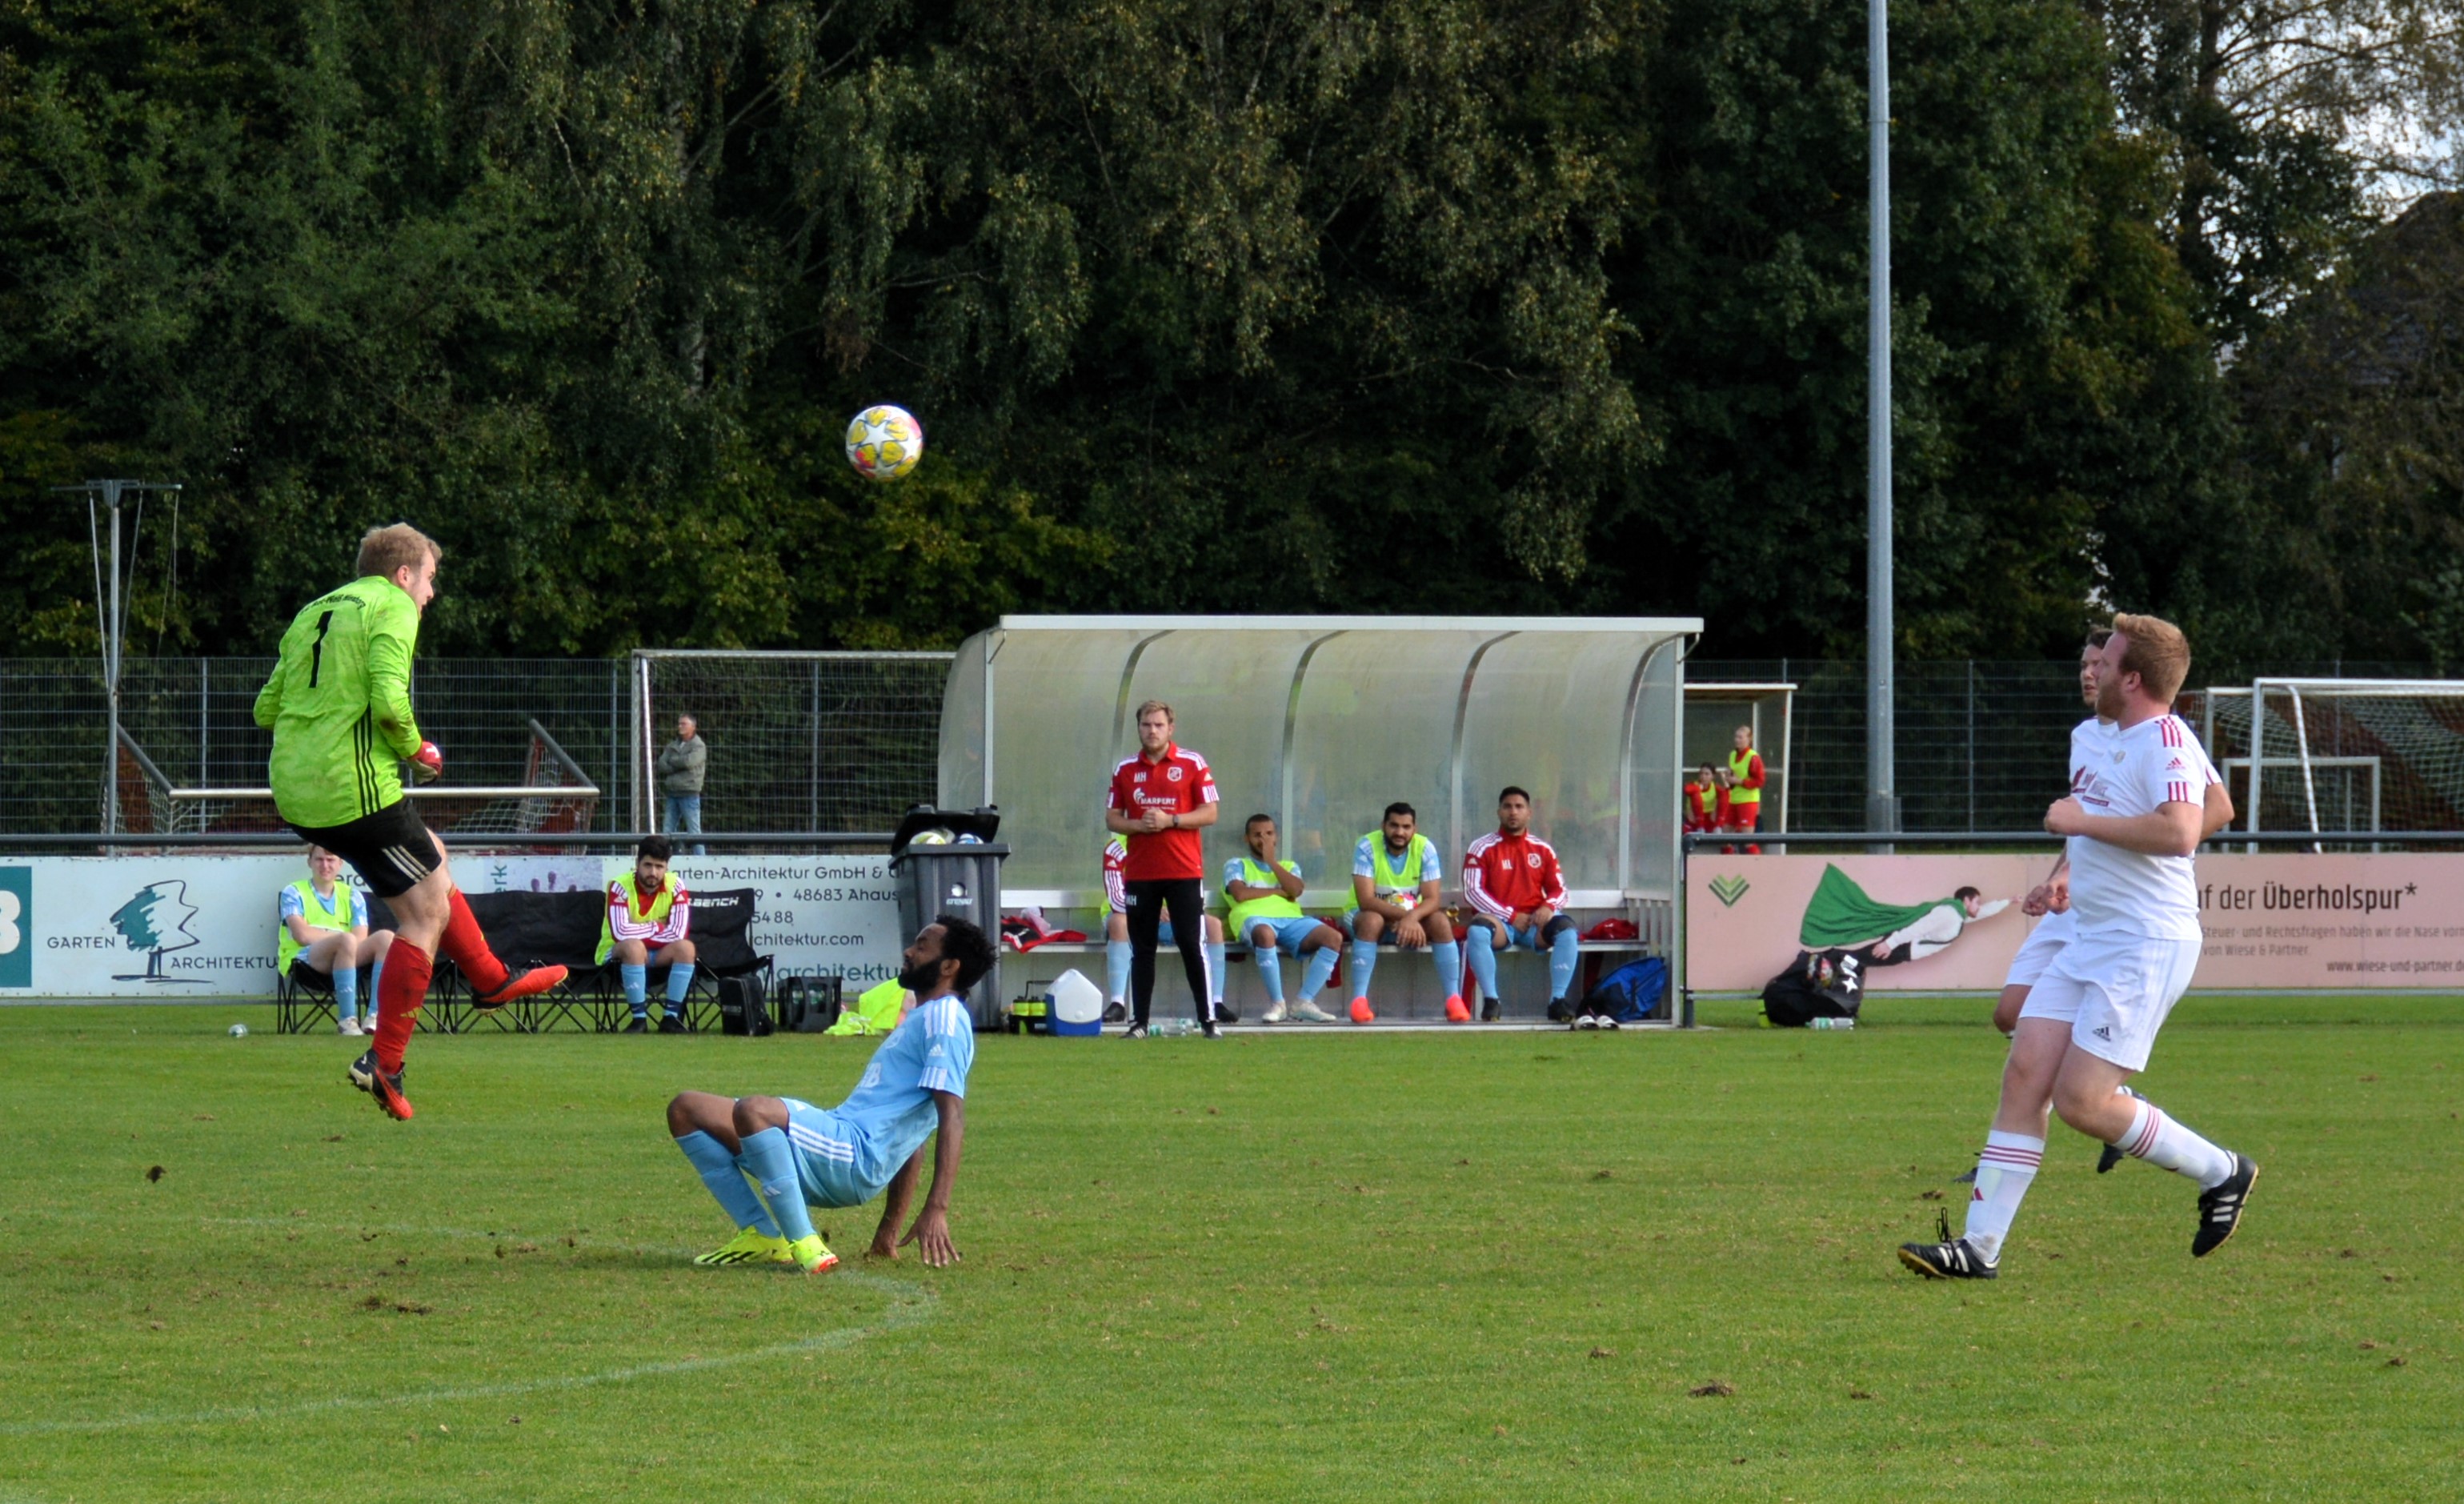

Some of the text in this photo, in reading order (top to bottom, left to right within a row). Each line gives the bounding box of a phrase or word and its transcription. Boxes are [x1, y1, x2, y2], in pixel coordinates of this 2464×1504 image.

[308, 610, 334, 688] 1
[672, 866, 810, 880] arten-Architektur
[815, 866, 866, 879] GmbH
[871, 866, 883, 879] &
[793, 888, 843, 901] 48683
[848, 888, 899, 901] Ahaus
[2219, 884, 2257, 910] der
[754, 932, 864, 946] chitektur.com
[2242, 926, 2262, 937] und
[2266, 926, 2336, 940] Rechtsfragen
[2340, 926, 2372, 937] haben
[2375, 926, 2391, 937] wir
[2394, 926, 2411, 937] die
[2414, 926, 2440, 937] Nase
[46, 936, 115, 949] GARTEN
[2226, 945, 2255, 956] Wiese
[170, 956, 278, 969] ARCHITEKTU
[777, 963, 898, 982] architektu
